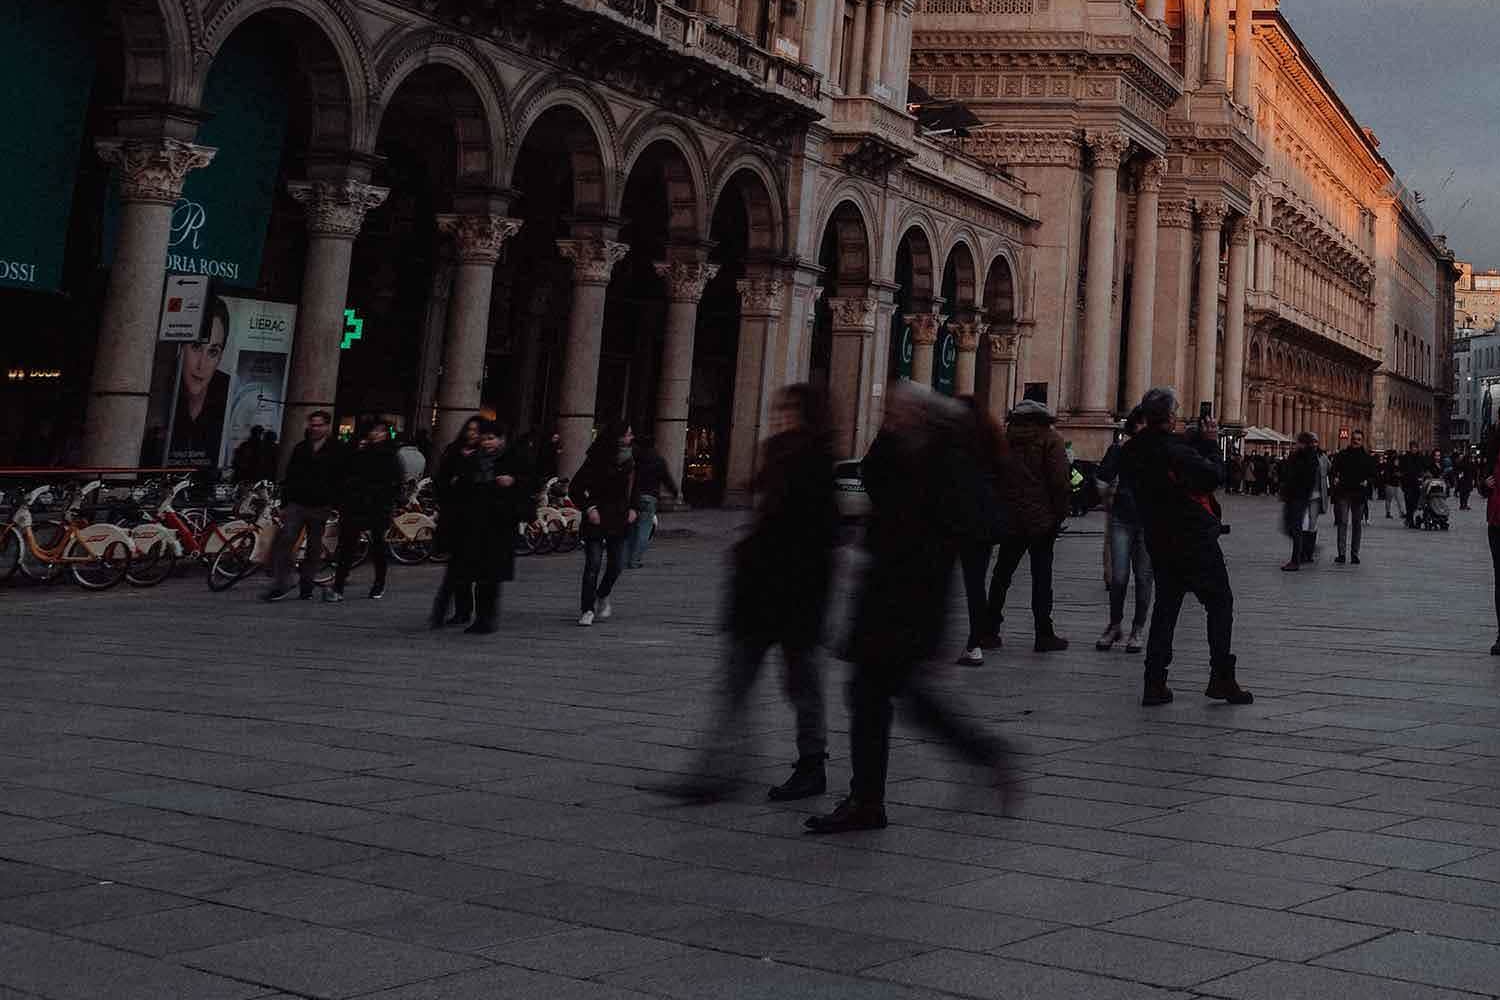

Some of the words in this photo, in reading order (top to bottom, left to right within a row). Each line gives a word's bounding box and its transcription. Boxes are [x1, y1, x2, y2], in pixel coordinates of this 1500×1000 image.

[0, 260, 36, 282] OSSI
[200, 258, 240, 280] ROSSI
[249, 316, 286, 332] LIERAC
